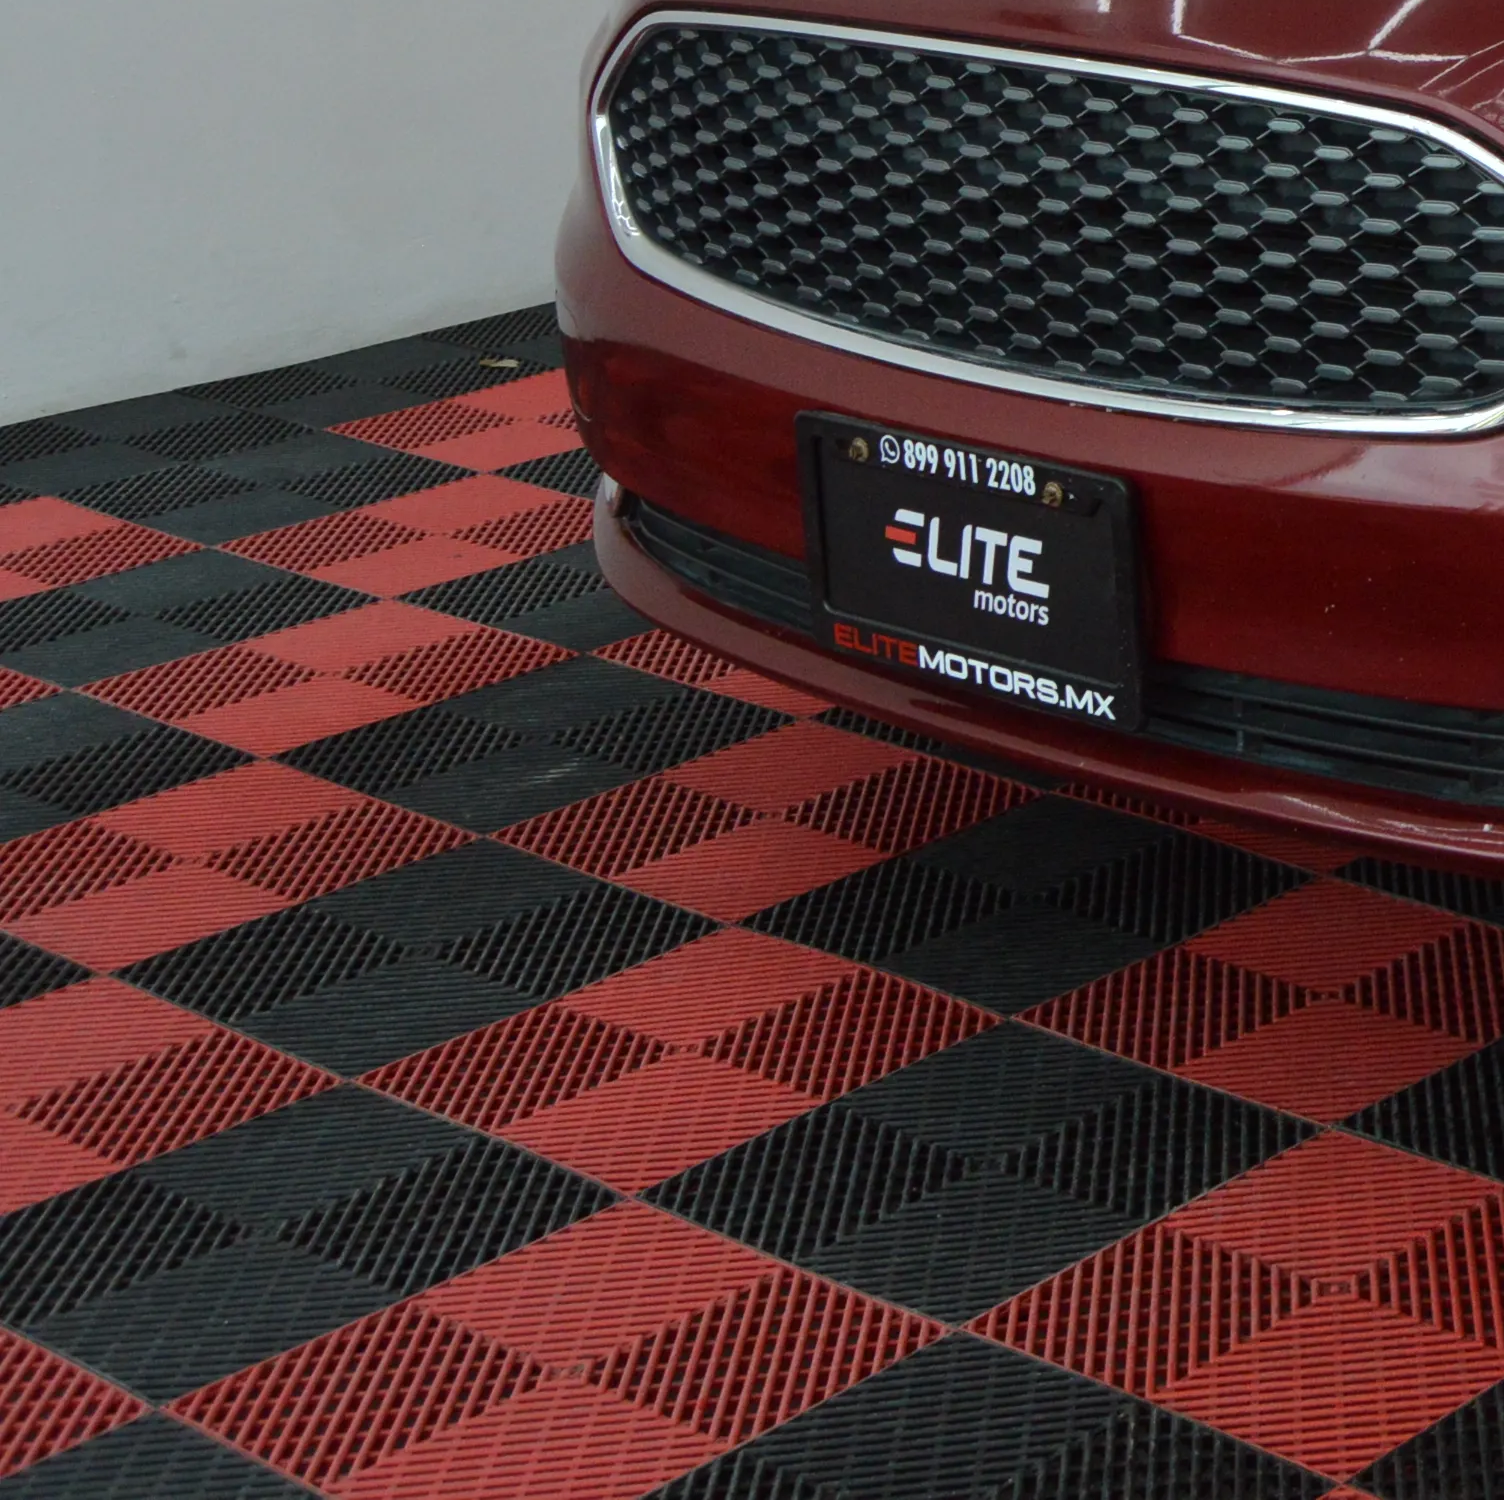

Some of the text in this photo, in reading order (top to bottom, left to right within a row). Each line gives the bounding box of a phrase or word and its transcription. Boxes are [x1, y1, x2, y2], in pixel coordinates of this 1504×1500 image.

[903, 439, 1036, 496] 899 911 2208
[885, 508, 1050, 598] ELITE
[973, 589, 1049, 626] motors
[833, 622, 1117, 721] ELITEMOTORS.MX
